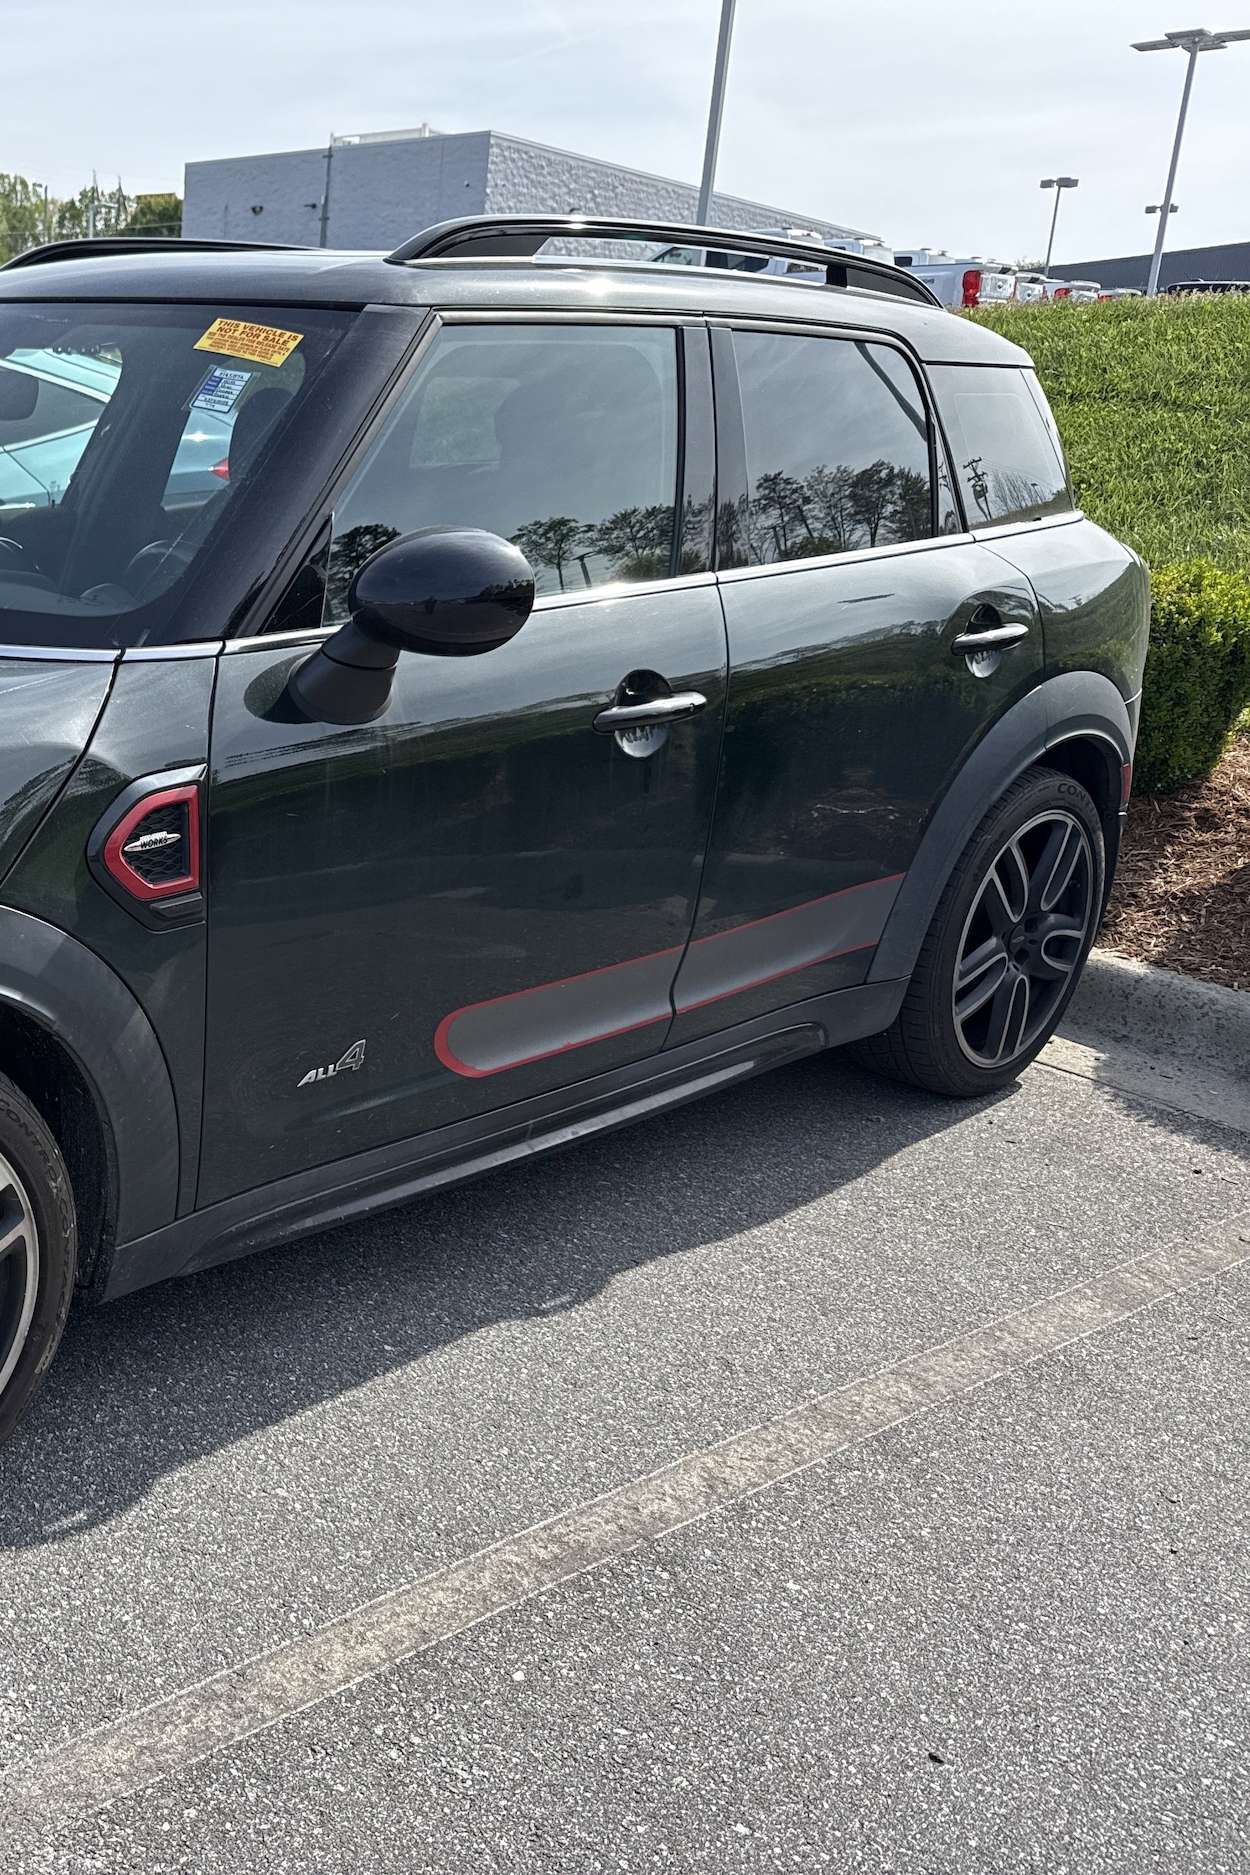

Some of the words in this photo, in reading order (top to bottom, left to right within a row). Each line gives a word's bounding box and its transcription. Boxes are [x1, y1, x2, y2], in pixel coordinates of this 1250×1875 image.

[216, 326, 239, 335] NOT
[239, 330, 261, 340] FOR
[262, 335, 290, 347] SALE
[218, 320, 240, 329] THIS
[243, 324, 286, 339] VEHICLE
[287, 334, 299, 342] IS
[140, 835, 168, 849] WORKS
